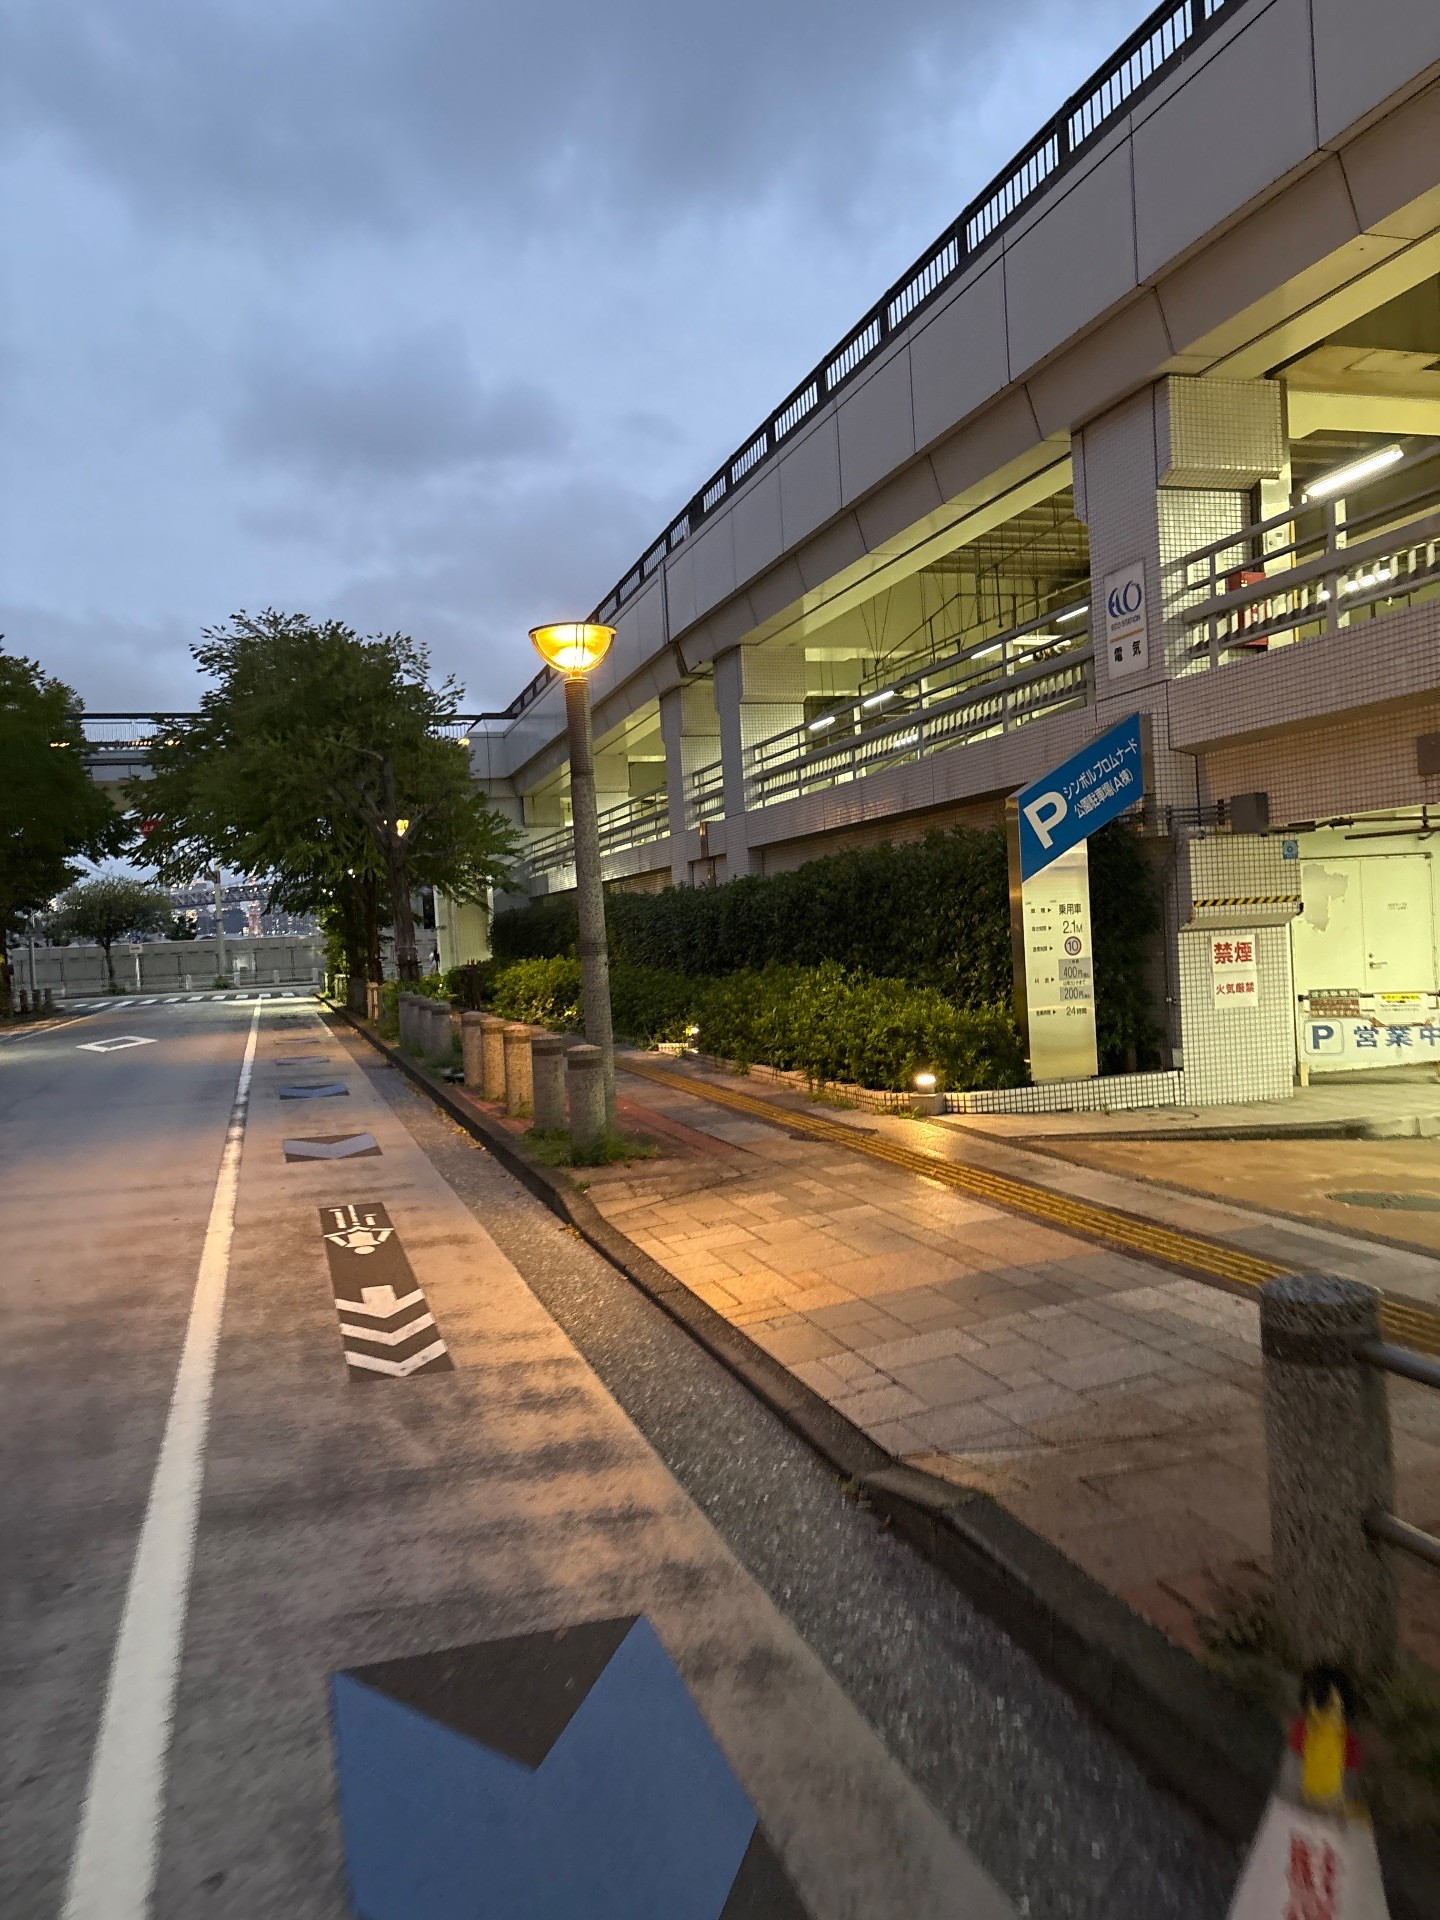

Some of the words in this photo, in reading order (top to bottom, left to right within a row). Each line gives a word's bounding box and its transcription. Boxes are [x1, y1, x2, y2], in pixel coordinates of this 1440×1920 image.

[1022, 791, 1068, 850] P
[1058, 903, 1082, 916] 乗用車
[1067, 940, 1079, 952] 10
[1213, 941, 1253, 965] 禁煙
[1216, 981, 1255, 996] 火気厳禁
[1311, 1024, 1334, 1050] P
